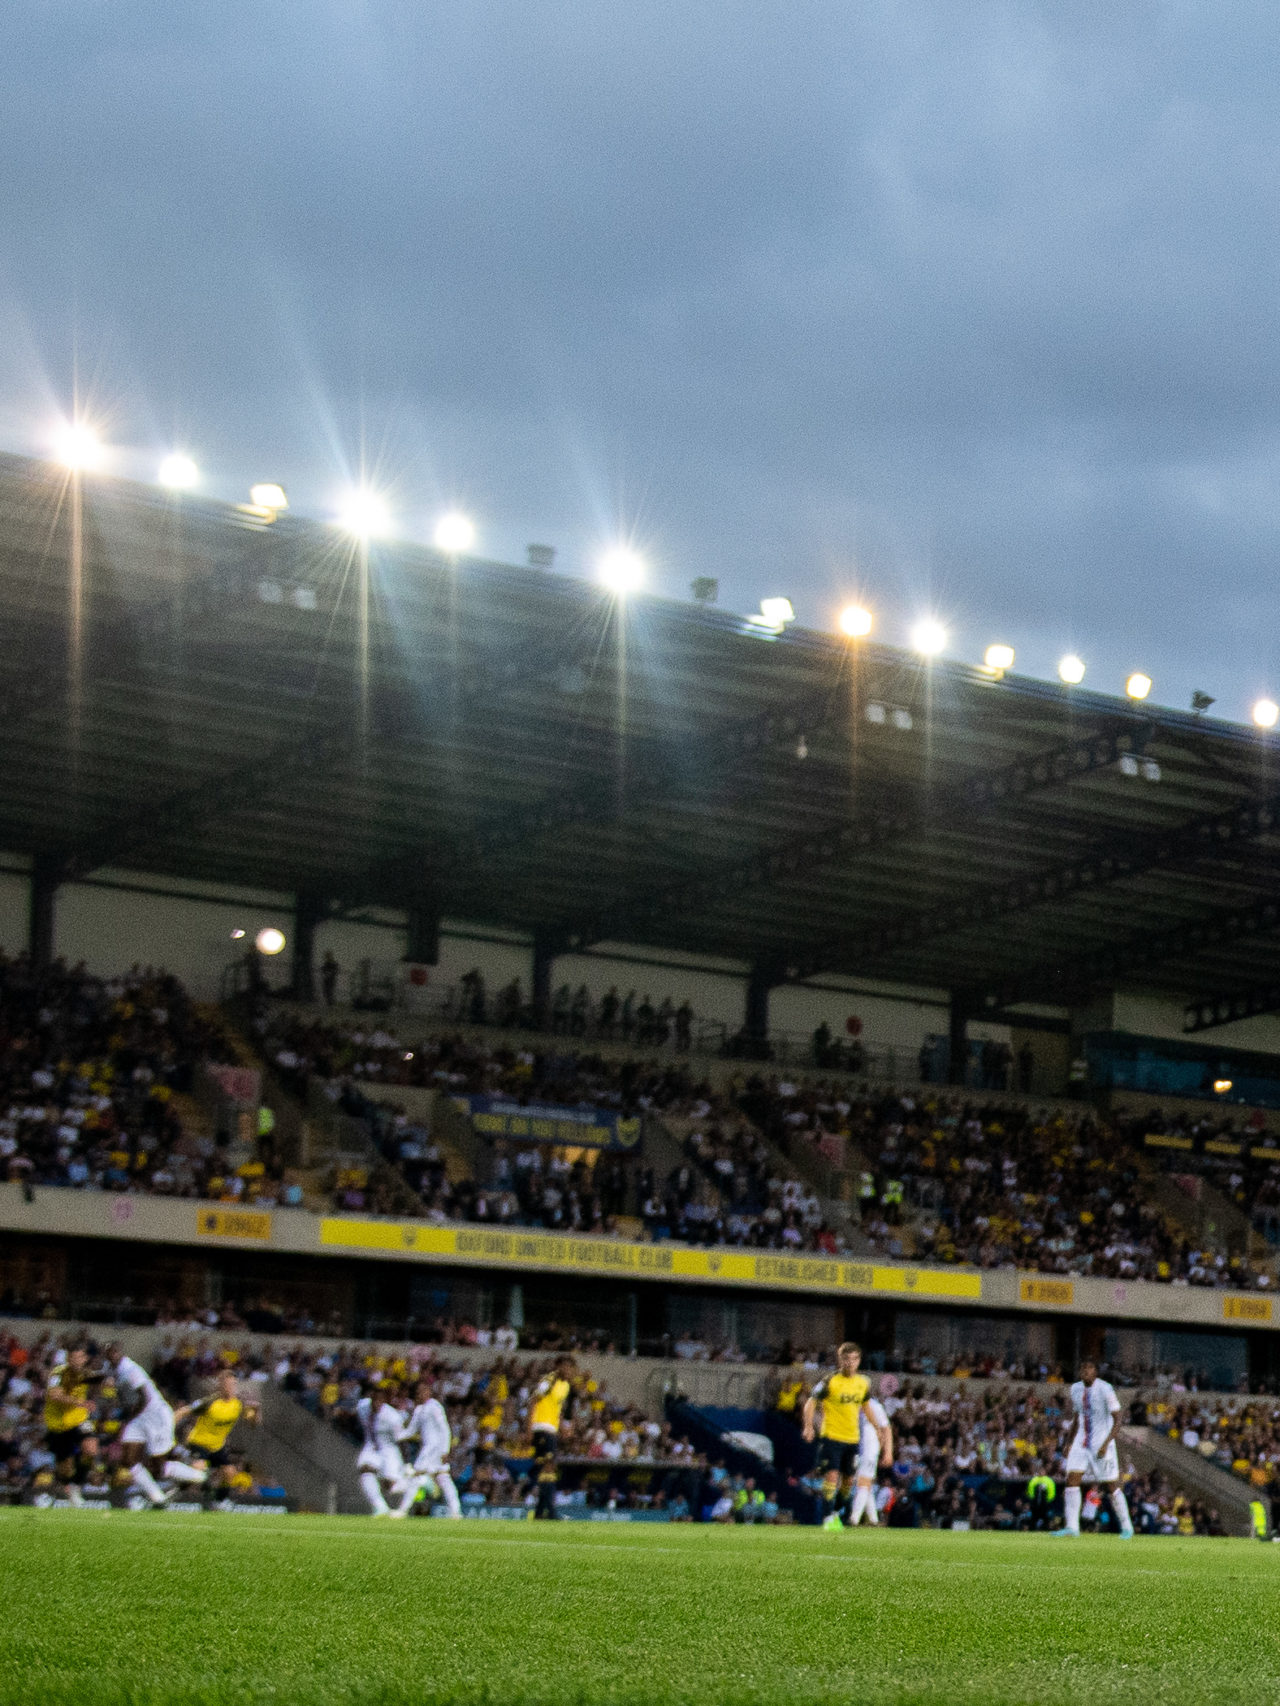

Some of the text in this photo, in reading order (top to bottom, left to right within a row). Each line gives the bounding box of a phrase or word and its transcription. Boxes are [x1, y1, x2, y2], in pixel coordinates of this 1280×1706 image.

[456, 1231, 673, 1271] OXFORD UNITED FOOTBALL CLUB
